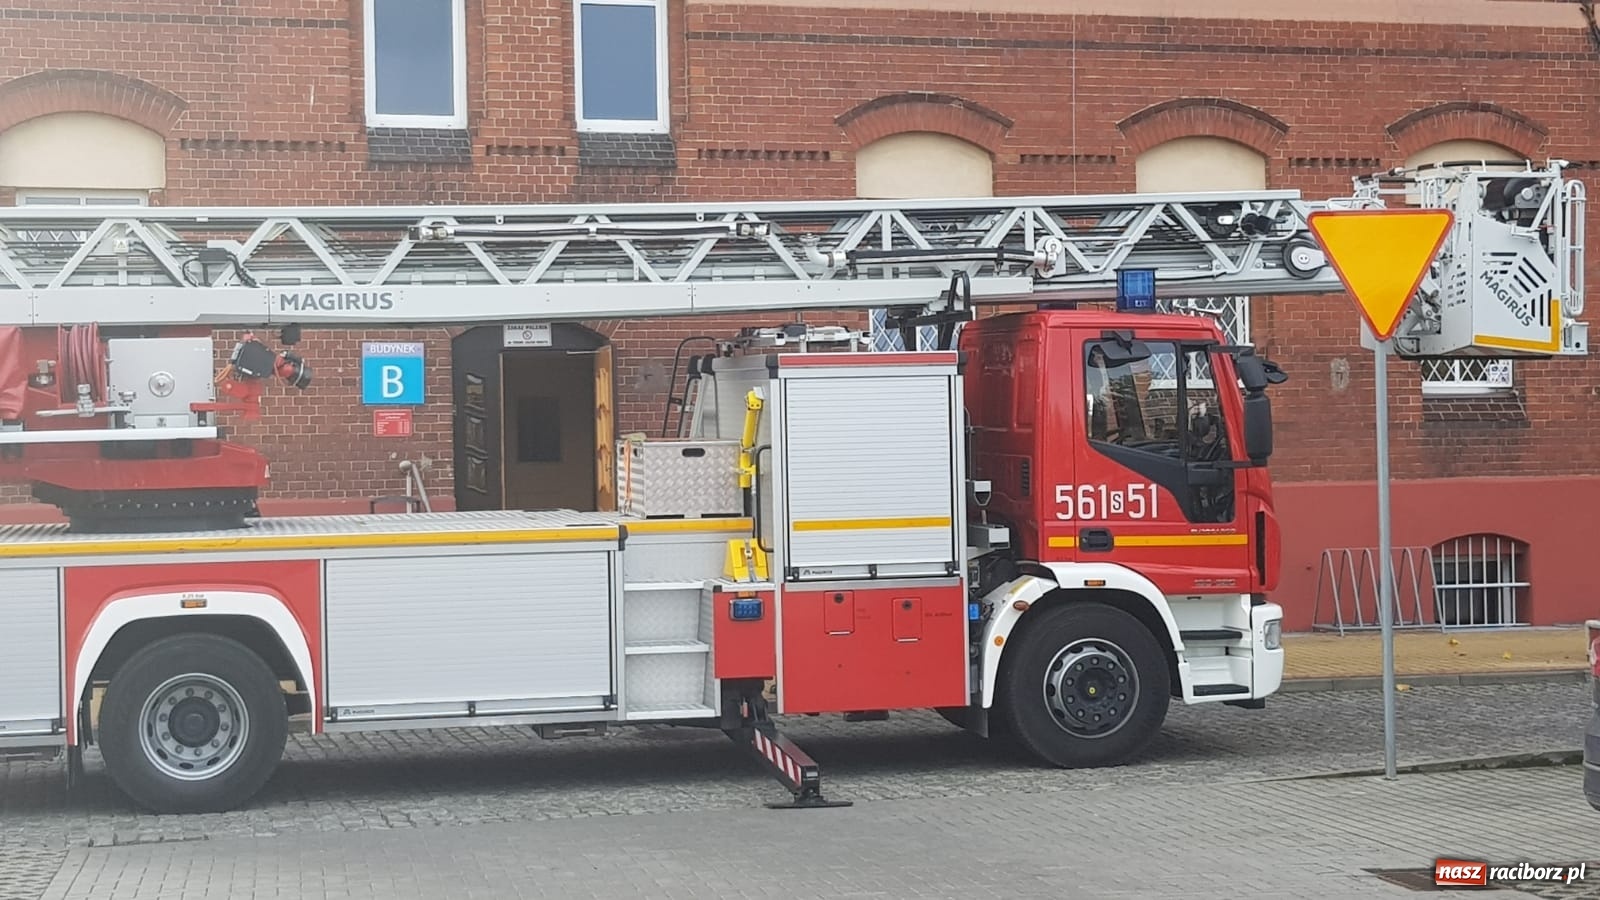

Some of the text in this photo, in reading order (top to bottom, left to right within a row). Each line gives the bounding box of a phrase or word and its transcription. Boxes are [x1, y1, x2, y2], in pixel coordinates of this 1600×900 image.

[280, 293, 393, 311] MAGIRUS
[1480, 270, 1533, 327] MAGIRUS
[370, 344, 416, 353] BUDYNEK
[382, 365, 404, 398] B
